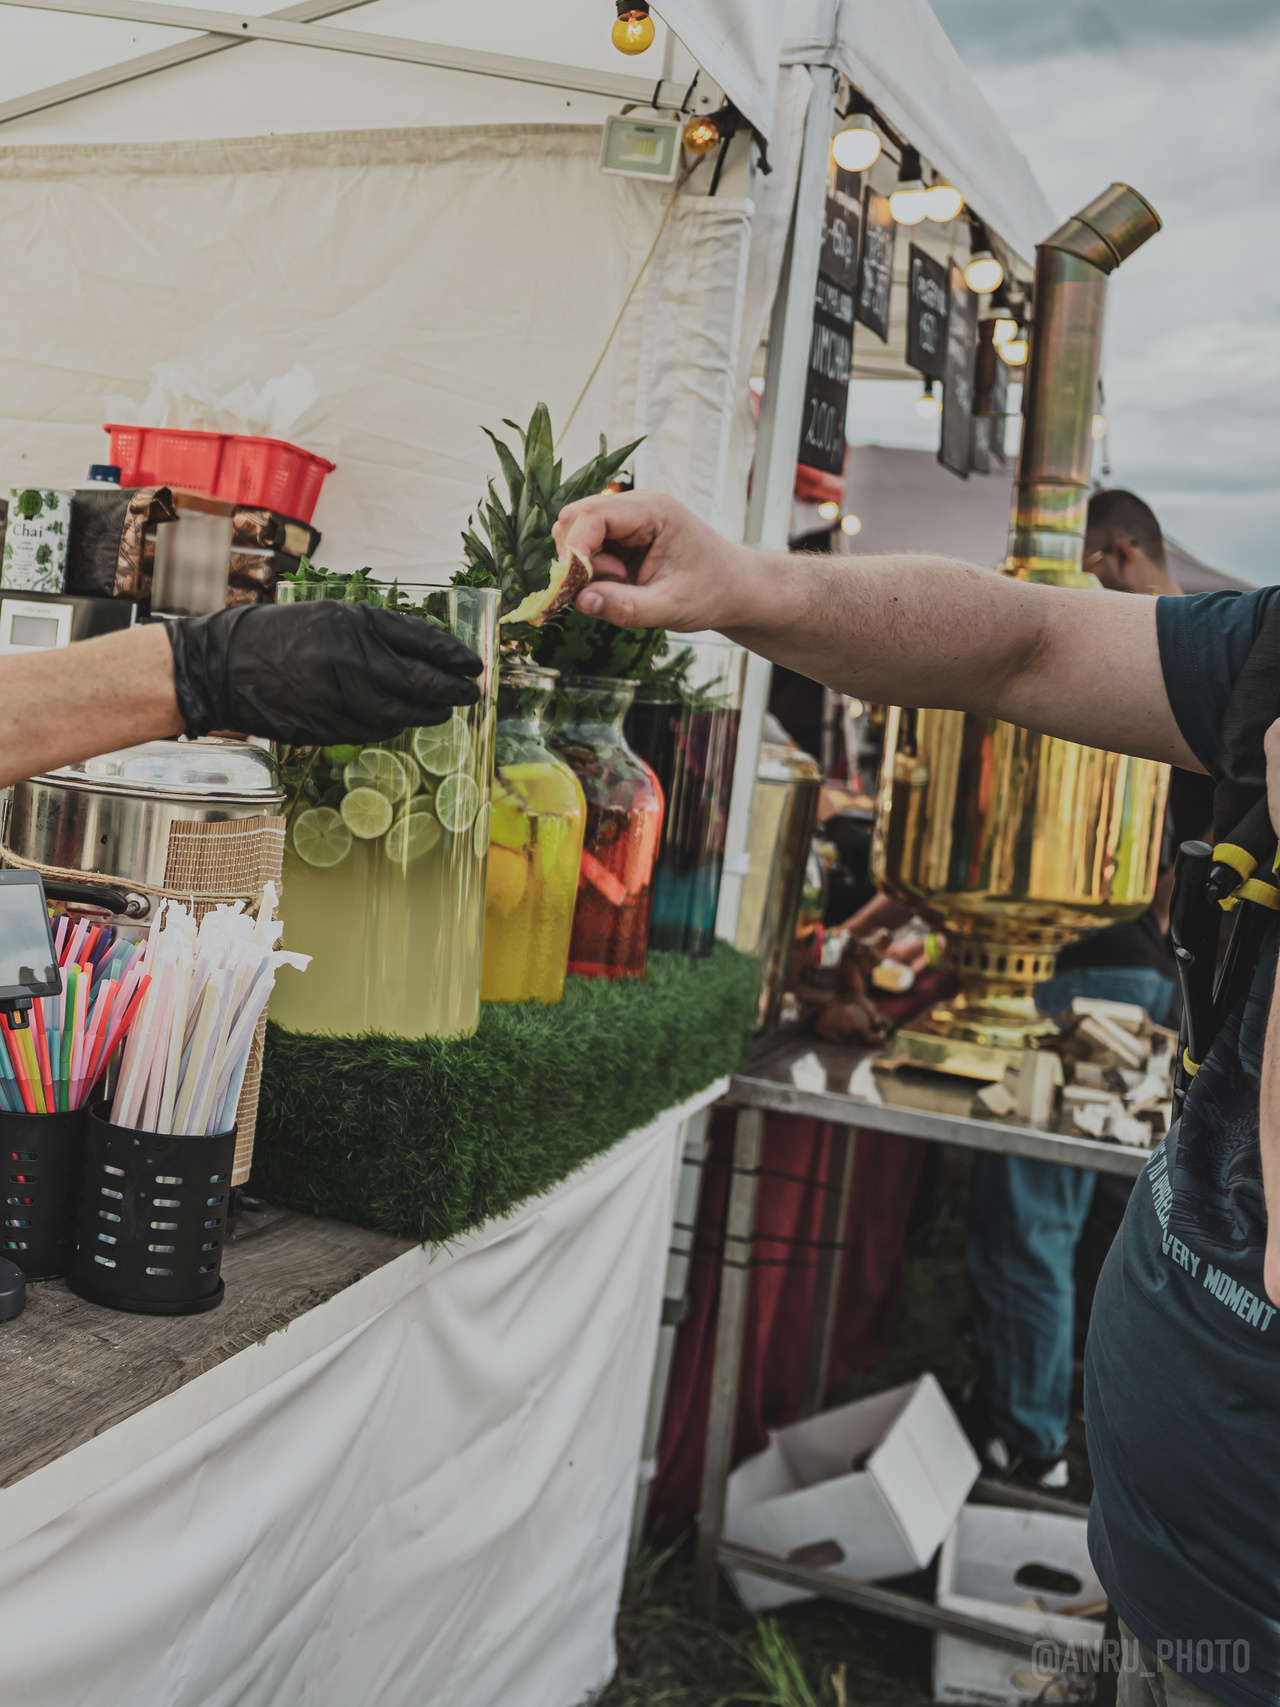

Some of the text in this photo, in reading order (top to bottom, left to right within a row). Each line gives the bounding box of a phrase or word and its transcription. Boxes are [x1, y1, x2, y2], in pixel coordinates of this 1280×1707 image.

[13, 523, 43, 538] Chai
[1146, 1154, 1168, 1182] TO
[1162, 1229, 1277, 1332] VERY MOMENT
